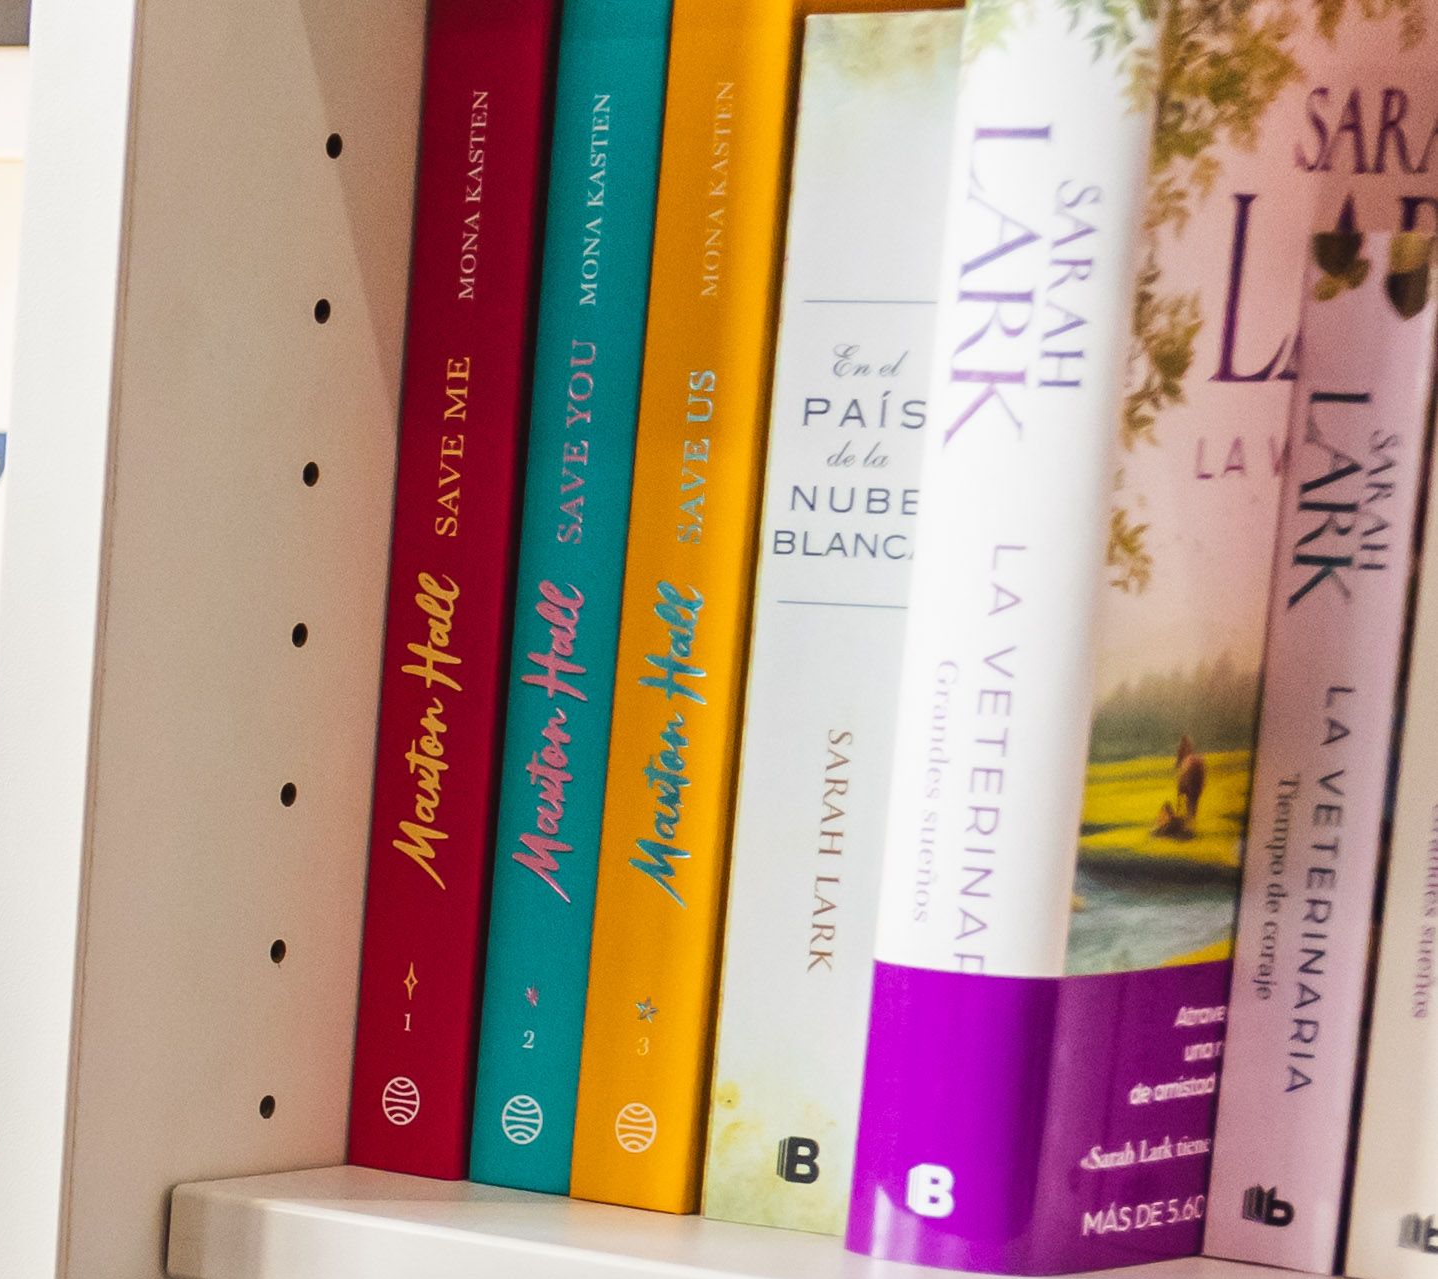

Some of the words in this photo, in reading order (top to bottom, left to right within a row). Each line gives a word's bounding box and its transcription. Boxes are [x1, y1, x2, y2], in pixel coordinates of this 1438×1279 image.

[465, 90, 488, 202] KASTEN
[587, 93, 611, 207] KASTEN
[710, 81, 734, 197] KASTEN
[459, 214, 482, 300] MONA
[580, 217, 603, 305] MONA
[701, 207, 726, 298] MONA
[943, 126, 1051, 447] LARK
[1038, 179, 1102, 388] SARAH
[444, 356, 471, 421] ME
[567, 338, 596, 428] YOU
[686, 369, 716, 421] US
[802, 391, 927, 429] PAÍS
[833, 344, 871, 377] En
[435, 434, 463, 538] SAVE
[558, 439, 588, 545] SAVE
[677, 437, 710, 545] SAVE
[790, 484, 920, 516] NUBE
[1287, 392, 1369, 607] LARK
[1360, 429, 1400, 571] SARAH
[772, 529, 914, 561] BLANC
[988, 544, 1027, 616] LA
[401, 572, 462, 692] Hall
[521, 580, 588, 702] Hall
[638, 580, 707, 705] Hall
[1321, 683, 1355, 745] LA
[393, 697, 445, 890] Maxton
[512, 707, 574, 904] Maxton
[628, 712, 692, 910] Maxton
[824, 728, 853, 856] SARAH
[807, 876, 841, 972] LARK
[1283, 769, 1345, 1092] VETERINARIA
[1083, 1201, 1131, 1236] MÁS
